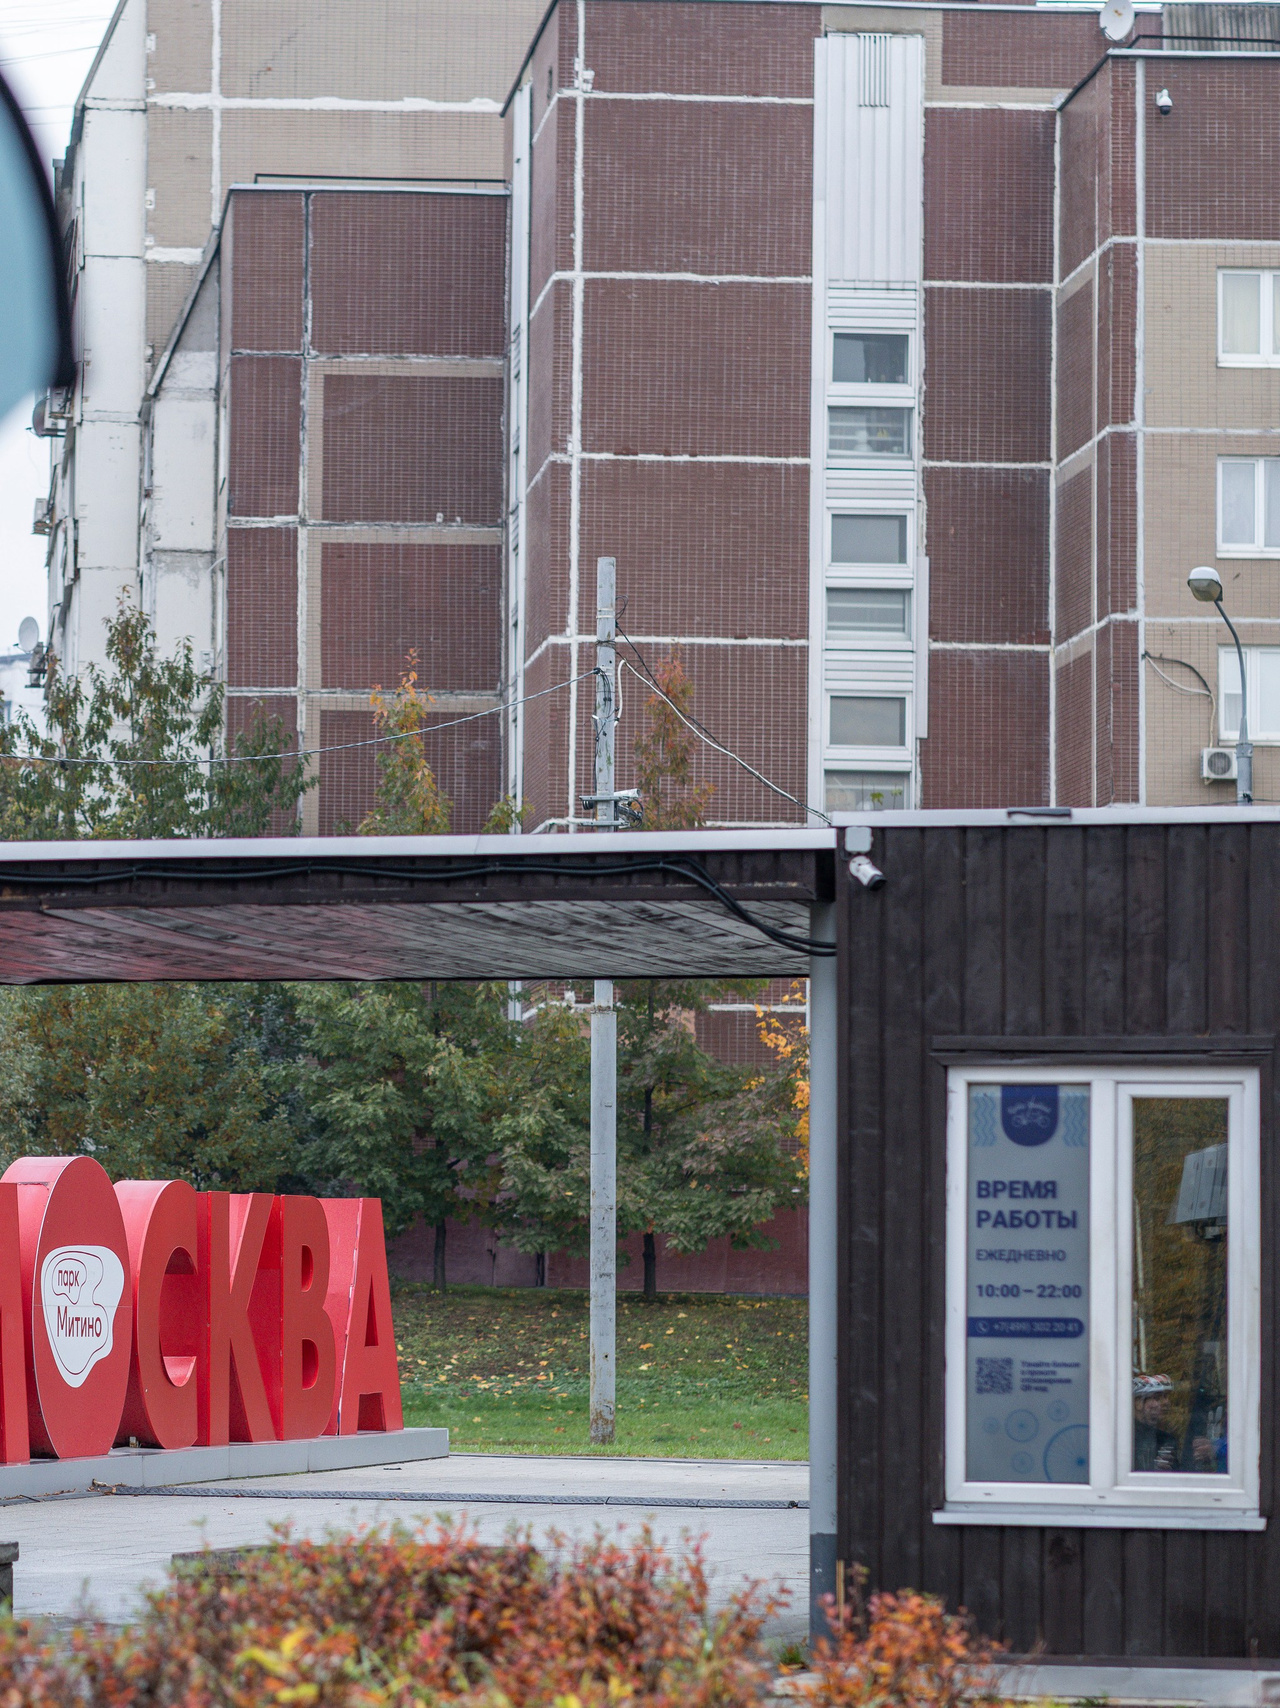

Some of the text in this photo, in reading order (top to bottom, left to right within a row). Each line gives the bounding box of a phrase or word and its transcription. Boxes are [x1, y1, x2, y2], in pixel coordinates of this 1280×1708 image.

[976, 1180, 1058, 1199] ВРЕМЯ
[976, 1209, 1077, 1229] РАБОТЫ
[976, 1248, 1066, 1263] ЕЖЕДНЕВНО
[57, 1269, 80, 1293] парк
[976, 1284, 1020, 1298] 10:00
[1036, 1284, 1082, 1299] 22:00
[57, 1305, 102, 1337] Митино
